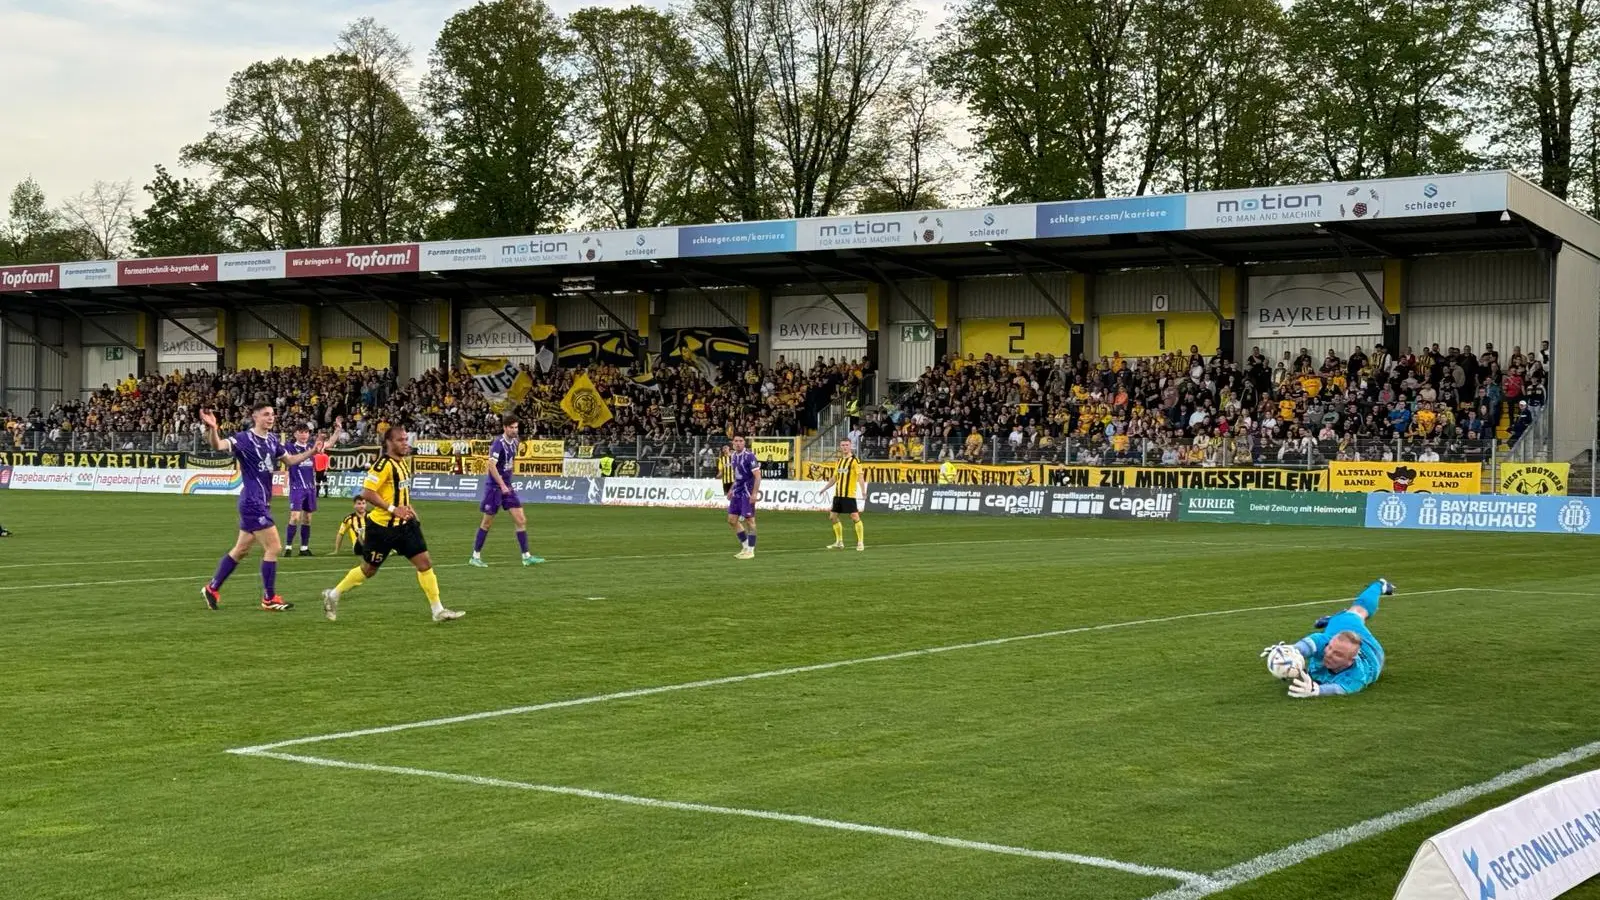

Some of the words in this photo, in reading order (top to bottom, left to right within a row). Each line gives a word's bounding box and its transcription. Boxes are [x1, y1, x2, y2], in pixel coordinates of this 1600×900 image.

[1216, 194, 1322, 212] motion
[1404, 200, 1457, 210] schlaeger
[1049, 209, 1168, 224] schlaeger.com/karriere
[1236, 214, 1256, 222] MAN
[1282, 210, 1322, 219] MACHINE
[820, 221, 901, 236] motion
[969, 227, 1009, 238] schlaeger
[692, 231, 785, 245] schlaeger.com/karriere
[501, 240, 568, 255] motion
[293, 259, 304, 267] Wir
[346, 250, 411, 270] Topform!
[2, 269, 53, 288] Topform!
[1259, 304, 1371, 327] BAYREUTH
[779, 321, 863, 340] BAYREUTH
[1009, 322, 1025, 353] 2
[1156, 319, 1165, 350] 1
[352, 342, 362, 366] 9
[64, 453, 180, 469] BAYREUTH
[520, 462, 563, 474] BAYREUTH
[13, 472, 73, 483] hagebaumarkt
[97, 474, 160, 486] hagebaumarkt
[1049, 469, 1090, 486] NIN
[1100, 470, 1125, 487] ZU
[1136, 470, 1321, 491] MONTAGSSPIELEN!
[1336, 469, 1383, 477] ALTSTADT
[1419, 470, 1473, 478] KULMBACH
[1526, 466, 1564, 492] BROTHERS
[525, 481, 541, 491] AM
[544, 480, 575, 490] BALL!
[605, 486, 703, 500] WEDLICH.COM
[870, 488, 925, 508] capelli
[985, 491, 1045, 511] capelli
[1109, 493, 1172, 515] capelli
[1188, 498, 1235, 509] KURIER
[1271, 504, 1298, 514] Zeitung
[1300, 505, 1312, 513] mit
[1313, 506, 1357, 514] Heimvorteil
[1440, 500, 1537, 514] BAYREUTHER
[1440, 513, 1537, 528] BRAUHAUS
[370, 551, 384, 563] 15
[1488, 818, 1596, 891] REGIONALLIGA
